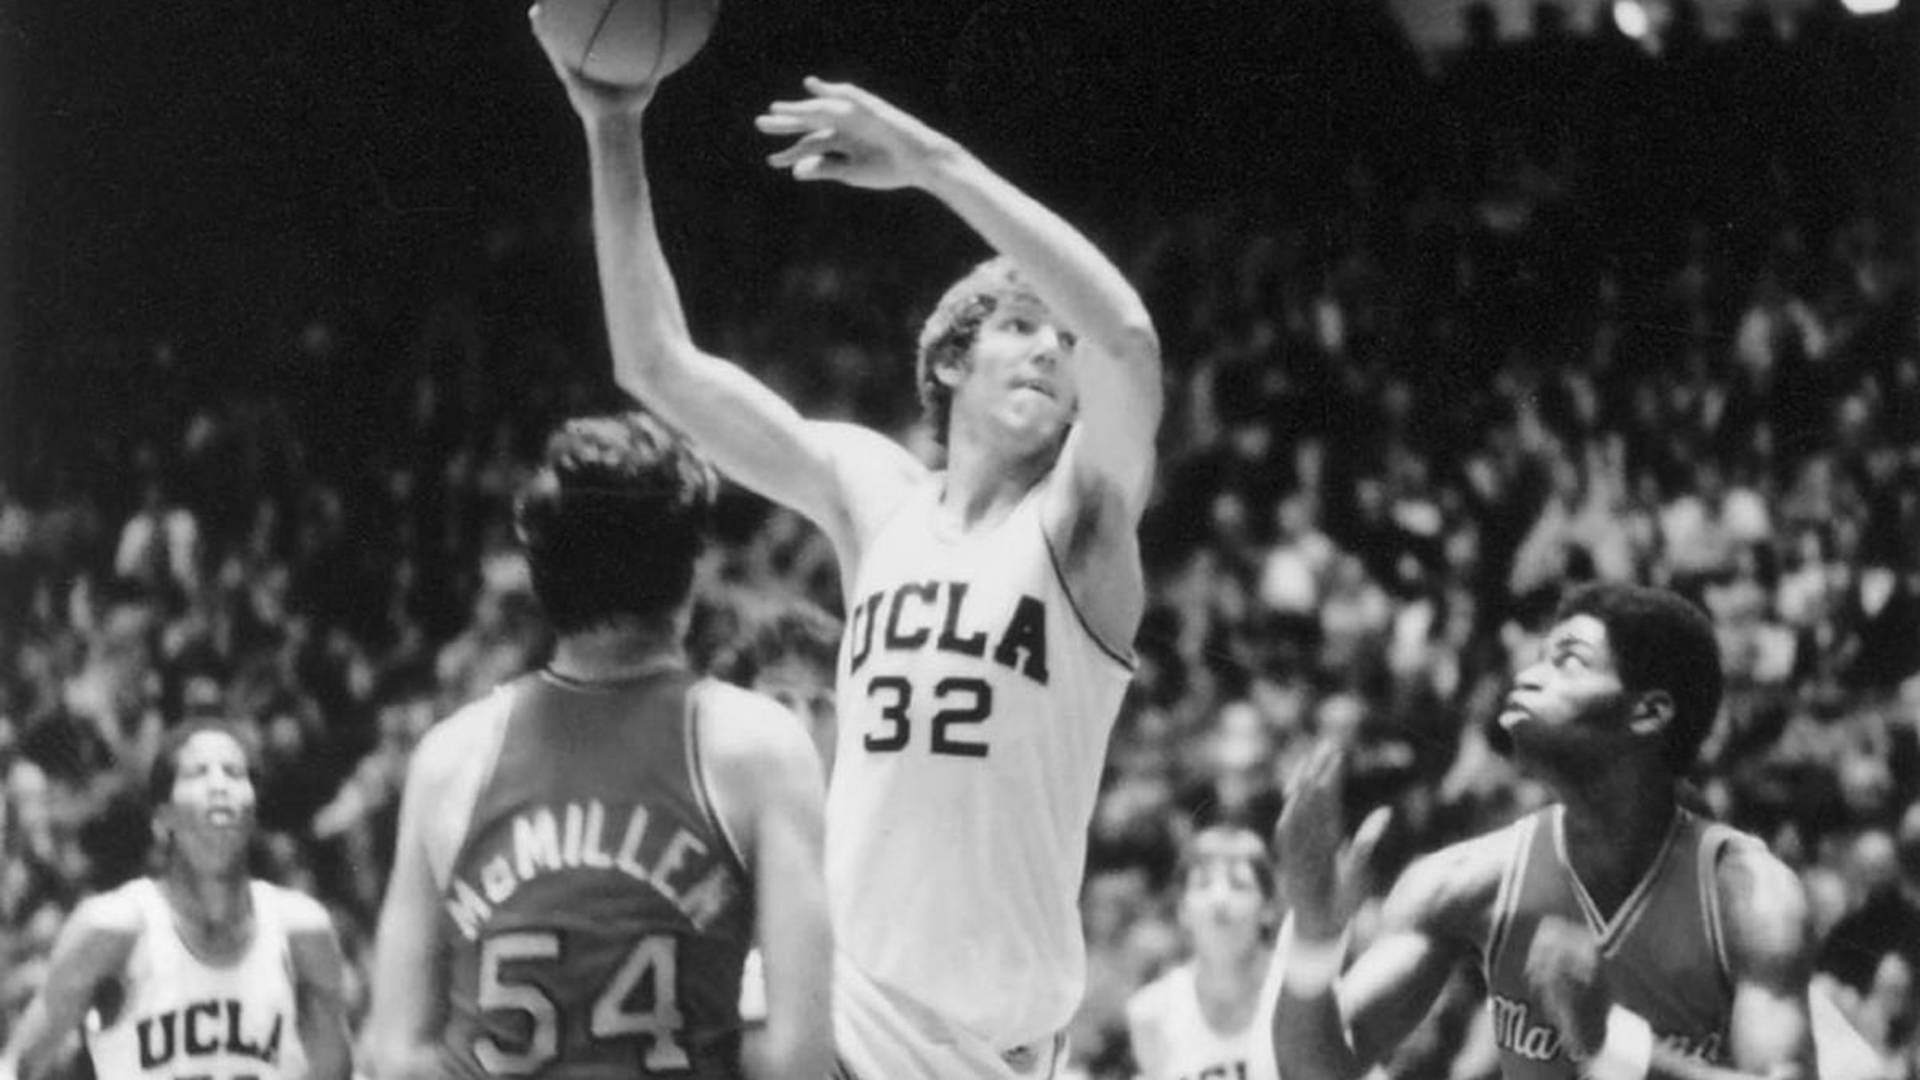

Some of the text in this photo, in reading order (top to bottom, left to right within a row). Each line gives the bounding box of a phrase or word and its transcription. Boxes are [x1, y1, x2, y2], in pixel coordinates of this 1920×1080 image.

[851, 580, 1048, 686] UCLA
[864, 675, 992, 758] 32
[474, 934, 690, 1075] 54
